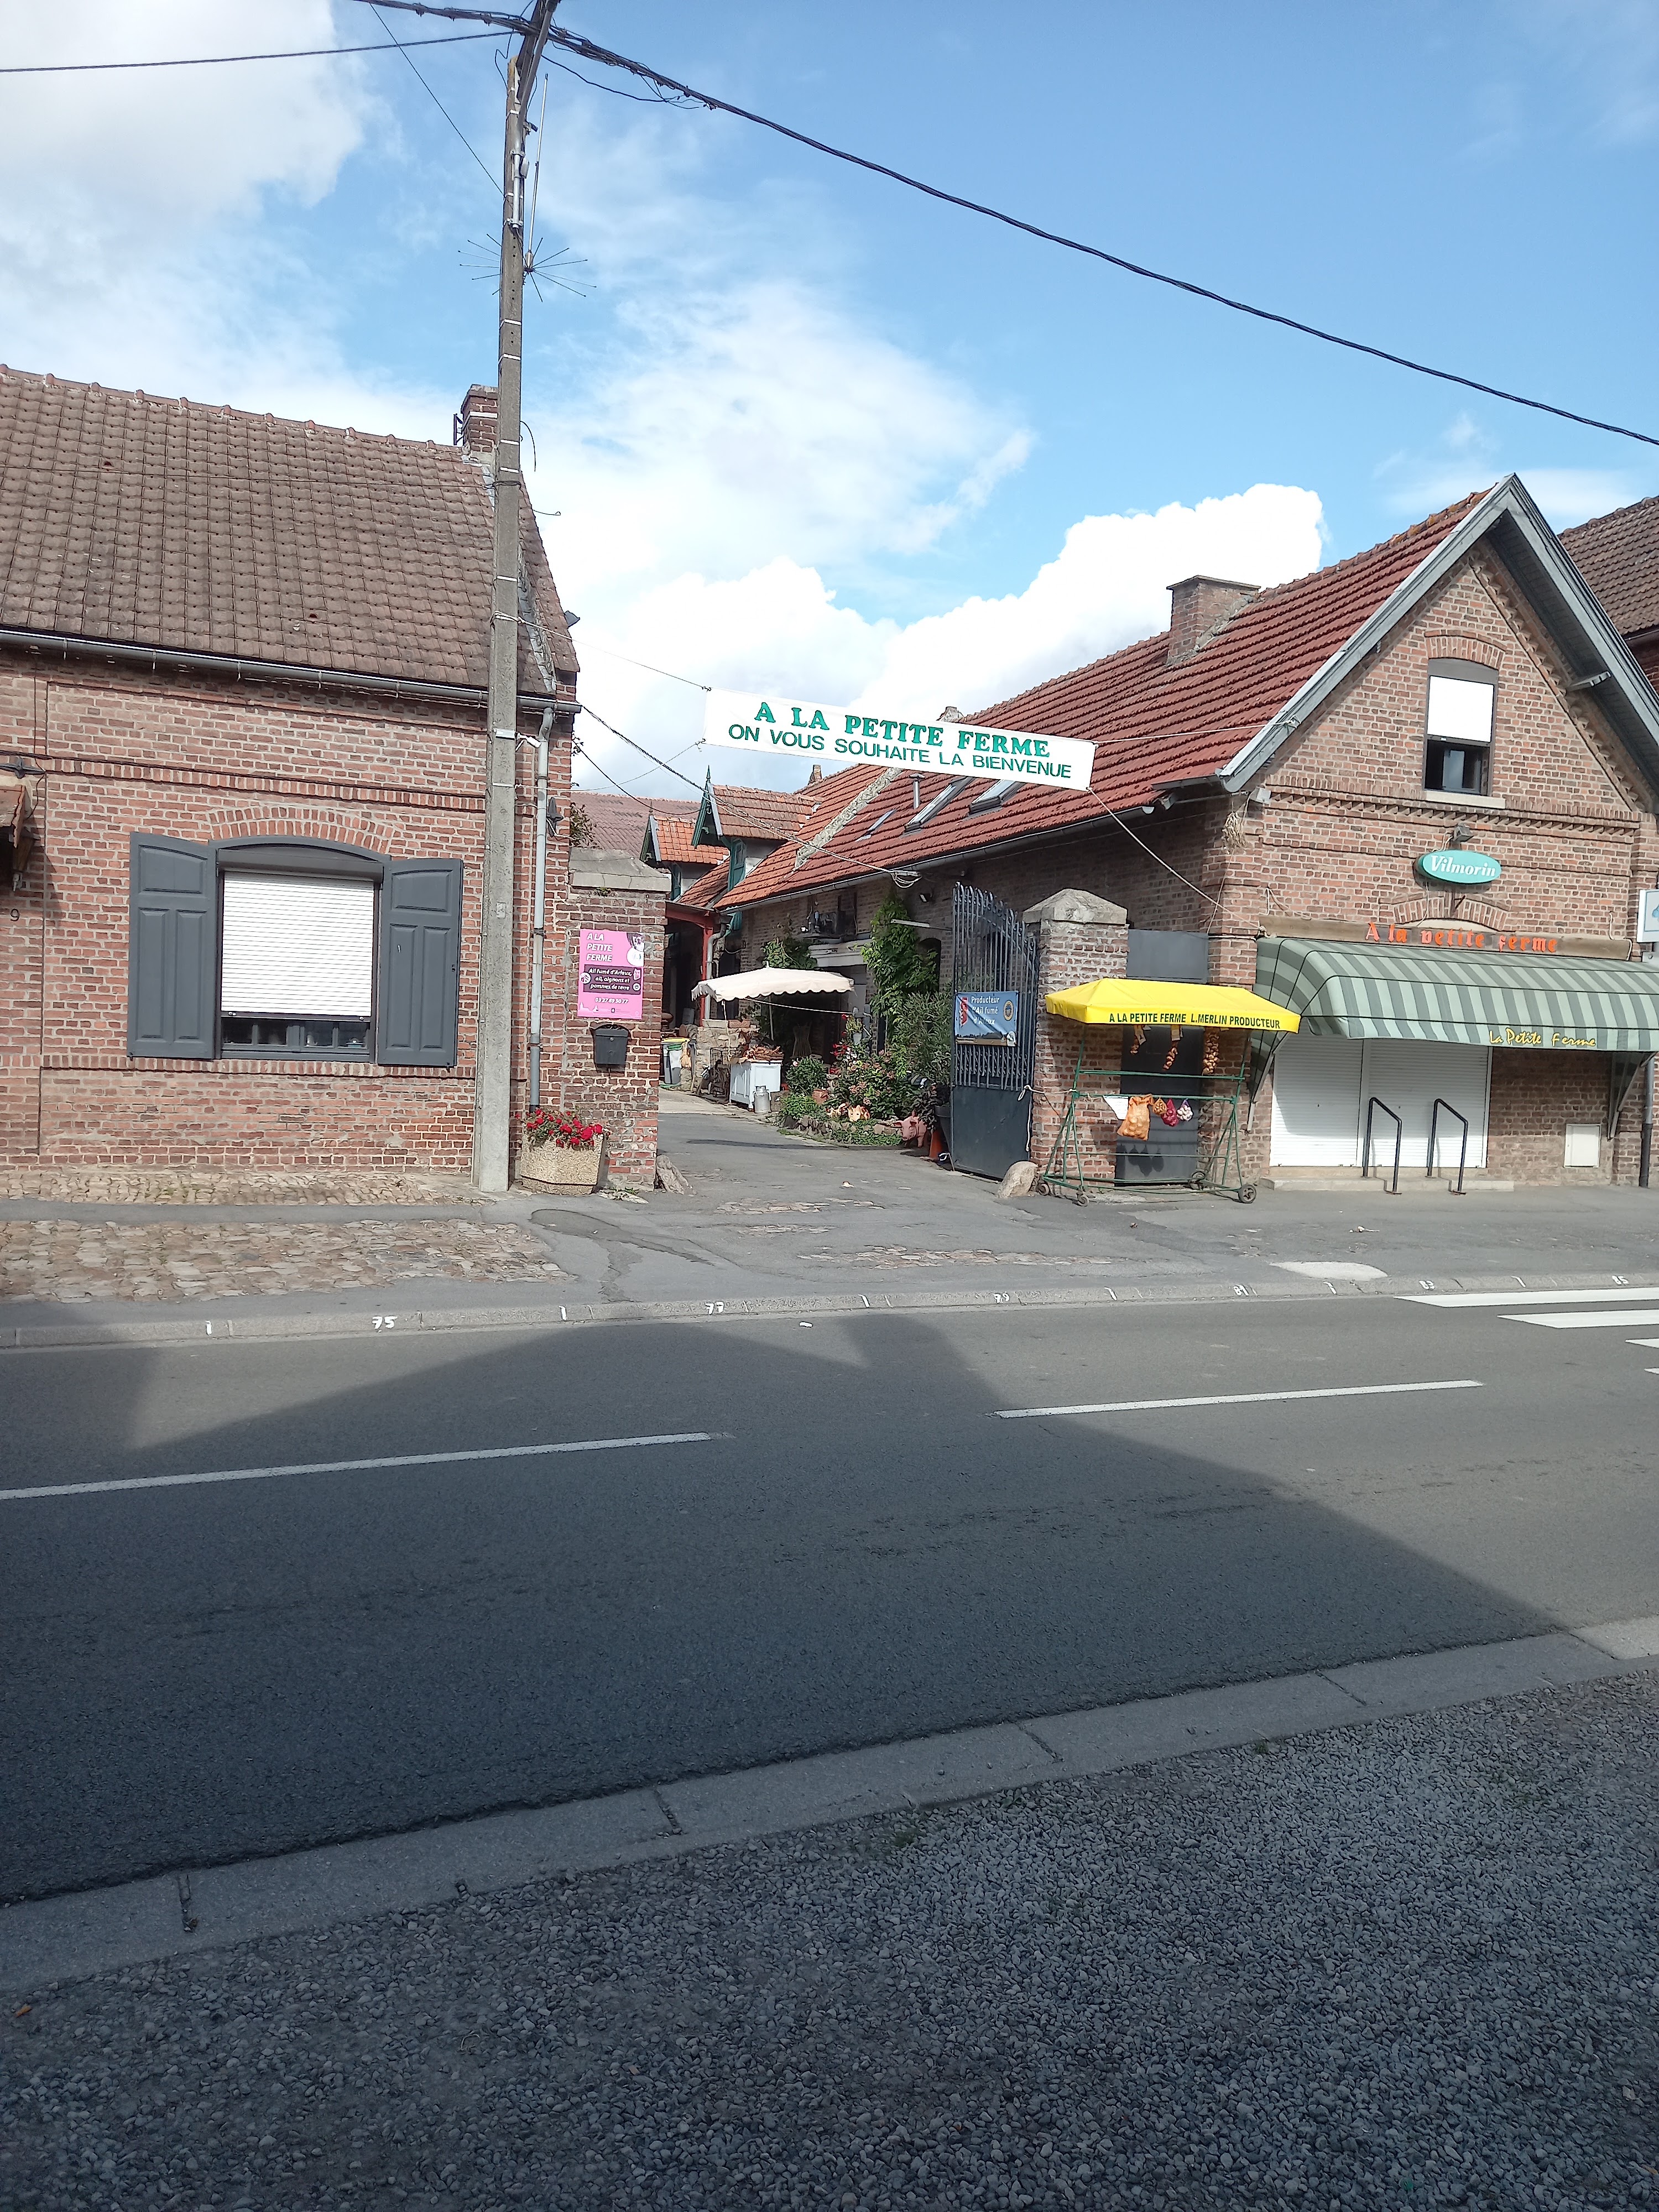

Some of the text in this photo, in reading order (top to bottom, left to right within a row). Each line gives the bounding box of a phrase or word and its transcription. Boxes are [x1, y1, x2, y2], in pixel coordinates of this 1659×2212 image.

[754, 702, 1050, 757] A LA PETITE FERME
[728, 724, 1072, 778] ON VOUS SOUHAITE LA BIENVENUE
[1430, 854, 1496, 877] Vilmorin
[10, 909, 20, 922] 9
[593, 933, 604, 941] LA
[1366, 922, 1380, 941] A
[1388, 924, 1408, 943] la
[1499, 934, 1558, 952] ferme
[587, 943, 613, 952] PETITE
[586, 953, 613, 962] FERME
[971, 995, 1000, 1004] Producteur
[984, 1006, 998, 1014] fumé
[1109, 1013, 1280, 1029] A LA PETITE FERME L.MERLIN PRODUCTEUR
[1505, 1027, 1542, 1045] Petite
[1551, 1032, 1596, 1047] Ferme
[705, 1301, 724, 1314] 77
[372, 1316, 398, 1329] 75
